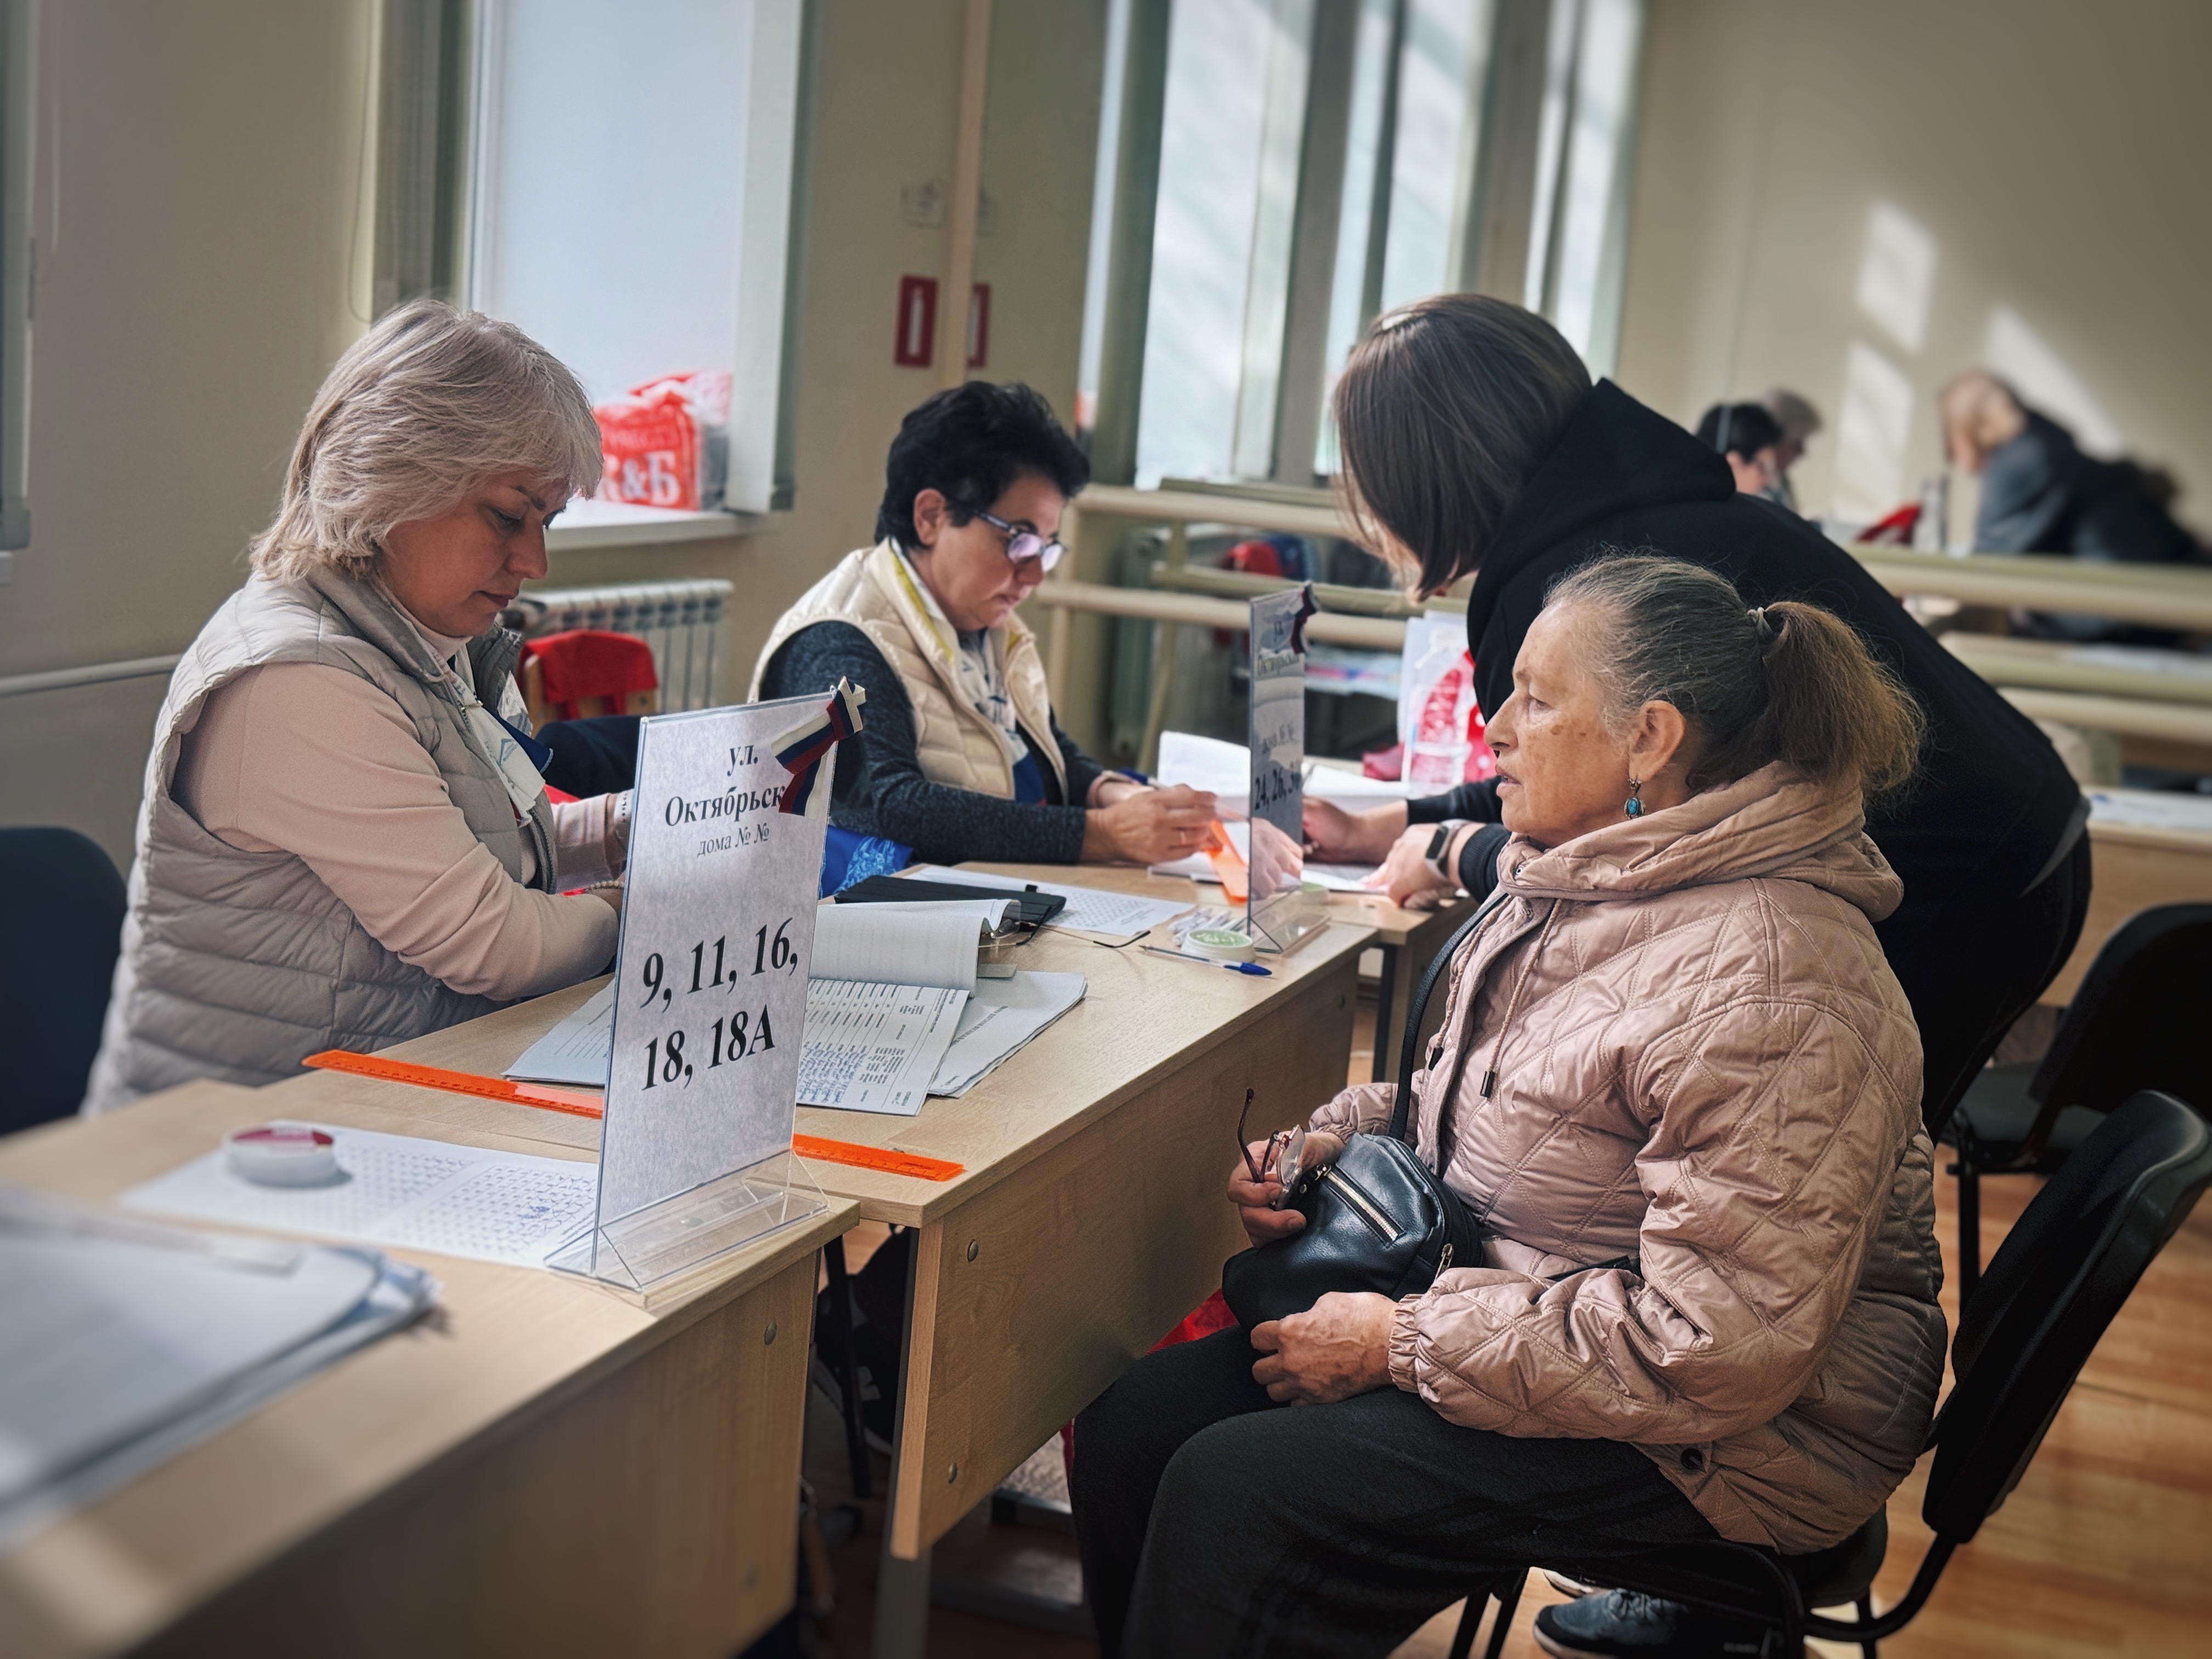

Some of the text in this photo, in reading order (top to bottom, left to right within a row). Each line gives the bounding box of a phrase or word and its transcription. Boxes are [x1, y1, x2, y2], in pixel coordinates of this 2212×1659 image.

[727, 745, 758, 776] ул.
[665, 786, 786, 826] Октябрьск
[697, 823, 769, 857] дома № №
[640, 917, 798, 1013] 9, 11, 16,
[641, 1030, 693, 1091] 18,
[708, 1003, 775, 1069] 18А
